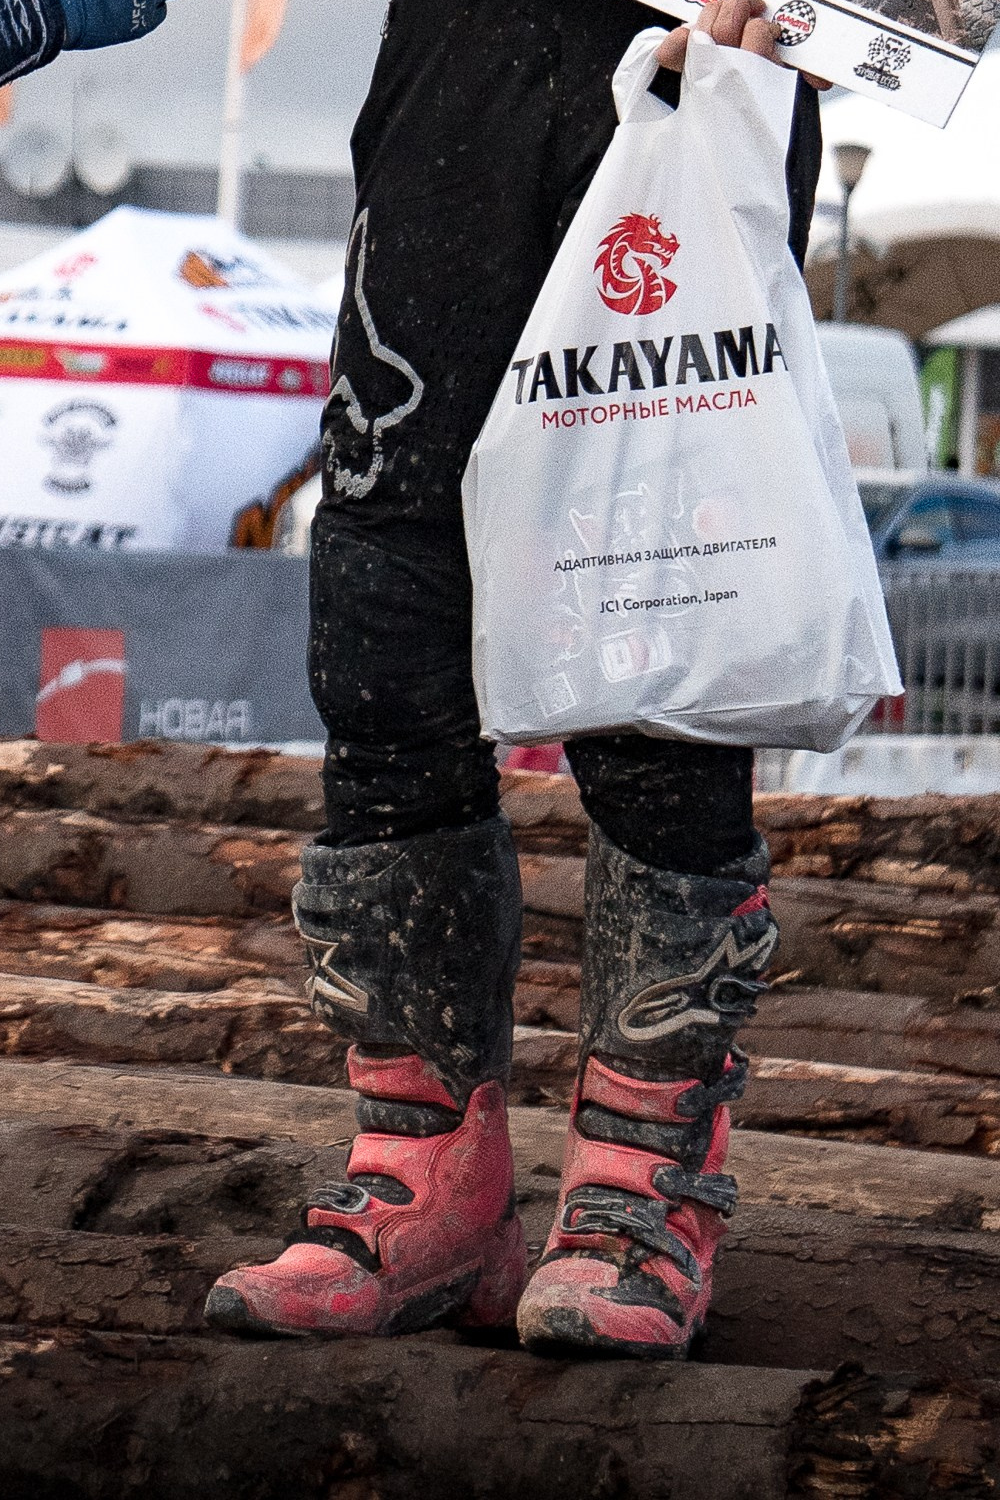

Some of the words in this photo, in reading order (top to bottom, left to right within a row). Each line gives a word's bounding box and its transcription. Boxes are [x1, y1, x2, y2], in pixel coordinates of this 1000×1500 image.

[511, 323, 789, 406] TAKAYAMA
[541, 397, 669, 431] МОТОРНЫЕ
[675, 388, 758, 414] МАСЛА
[553, 550, 642, 573] АДАПТИВНАЯ
[644, 545, 700, 564] ЗАЩИТА
[702, 536, 777, 557] ДВИГАТЕЛЯ
[599, 601, 621, 614] JCI
[623, 593, 701, 614] Corporation,
[704, 588, 738, 606] Japan
[138, 698, 249, 740] НОВАЯ
